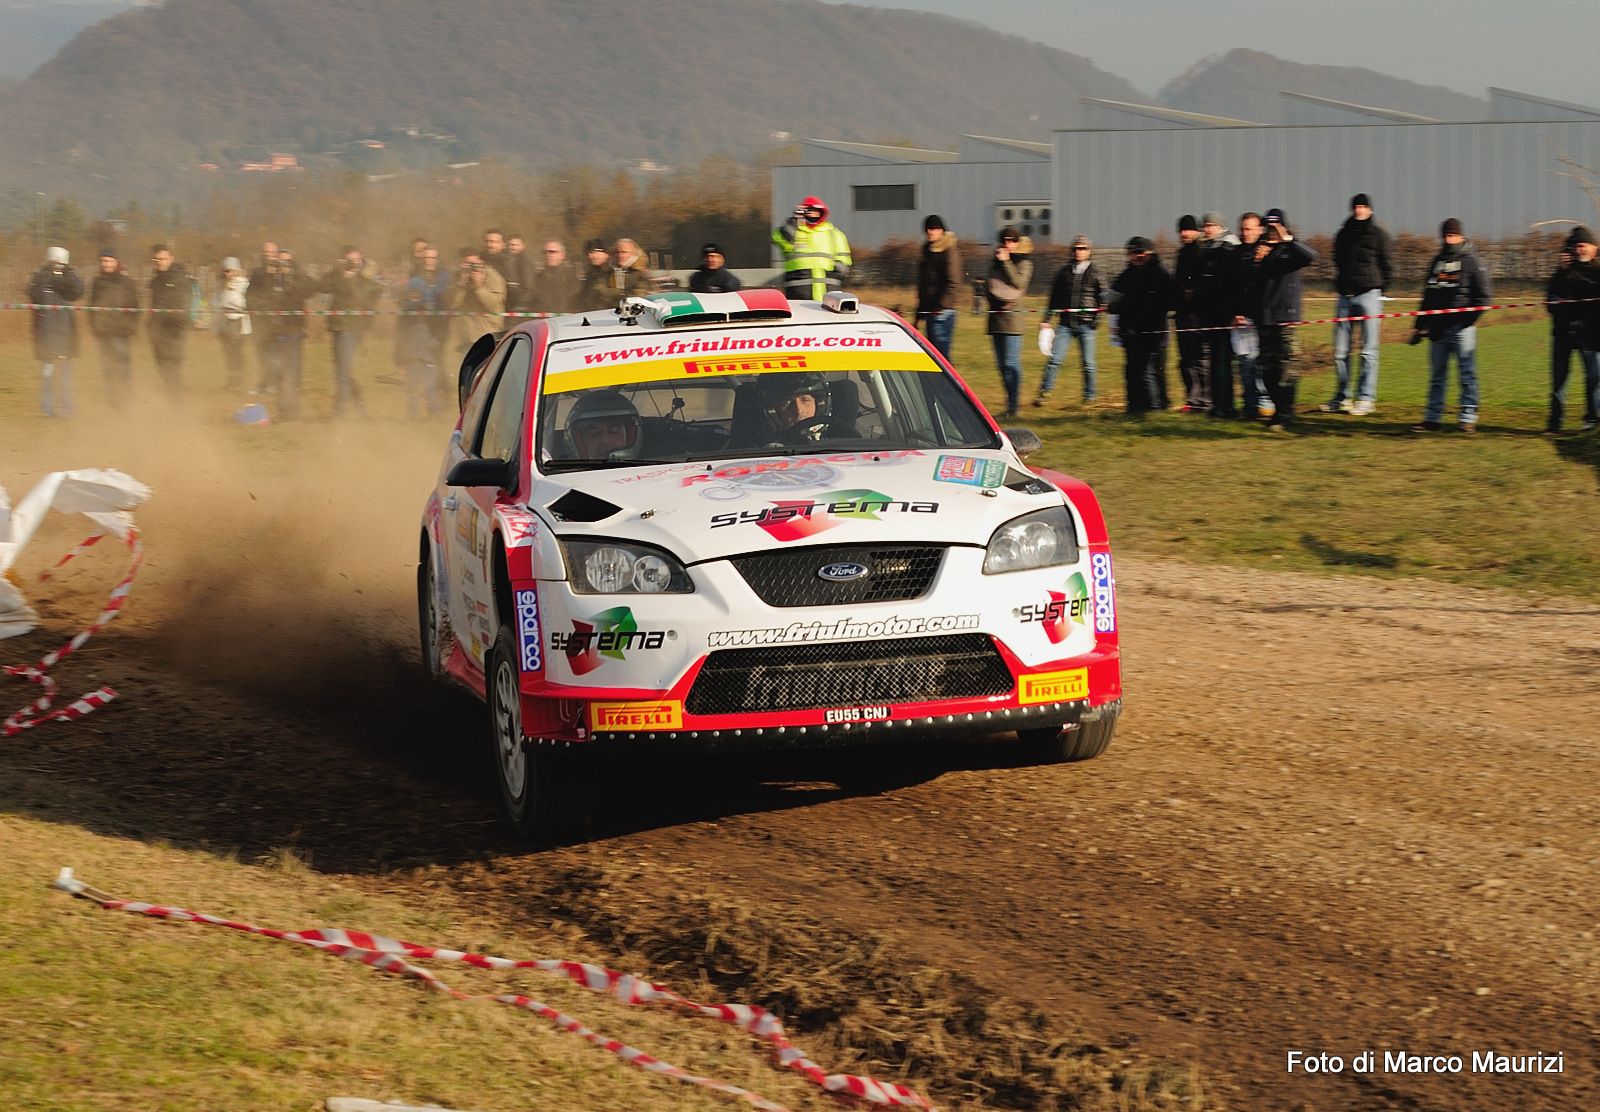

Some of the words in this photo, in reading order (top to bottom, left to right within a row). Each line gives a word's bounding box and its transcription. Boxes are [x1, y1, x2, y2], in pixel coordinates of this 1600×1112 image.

[584, 335, 882, 365] www.friulmotor.com
[684, 355, 807, 374] PIRELLI
[829, 564, 858, 576] Ford
[1092, 553, 1114, 632] sparco
[517, 590, 541, 671] sparco
[708, 614, 980, 647] www.friulmotor.com
[1026, 675, 1082, 697] PIRELLI
[598, 705, 672, 726] PIRELLI
[826, 709, 860, 723] EU55
[863, 706, 888, 720] CNJ
